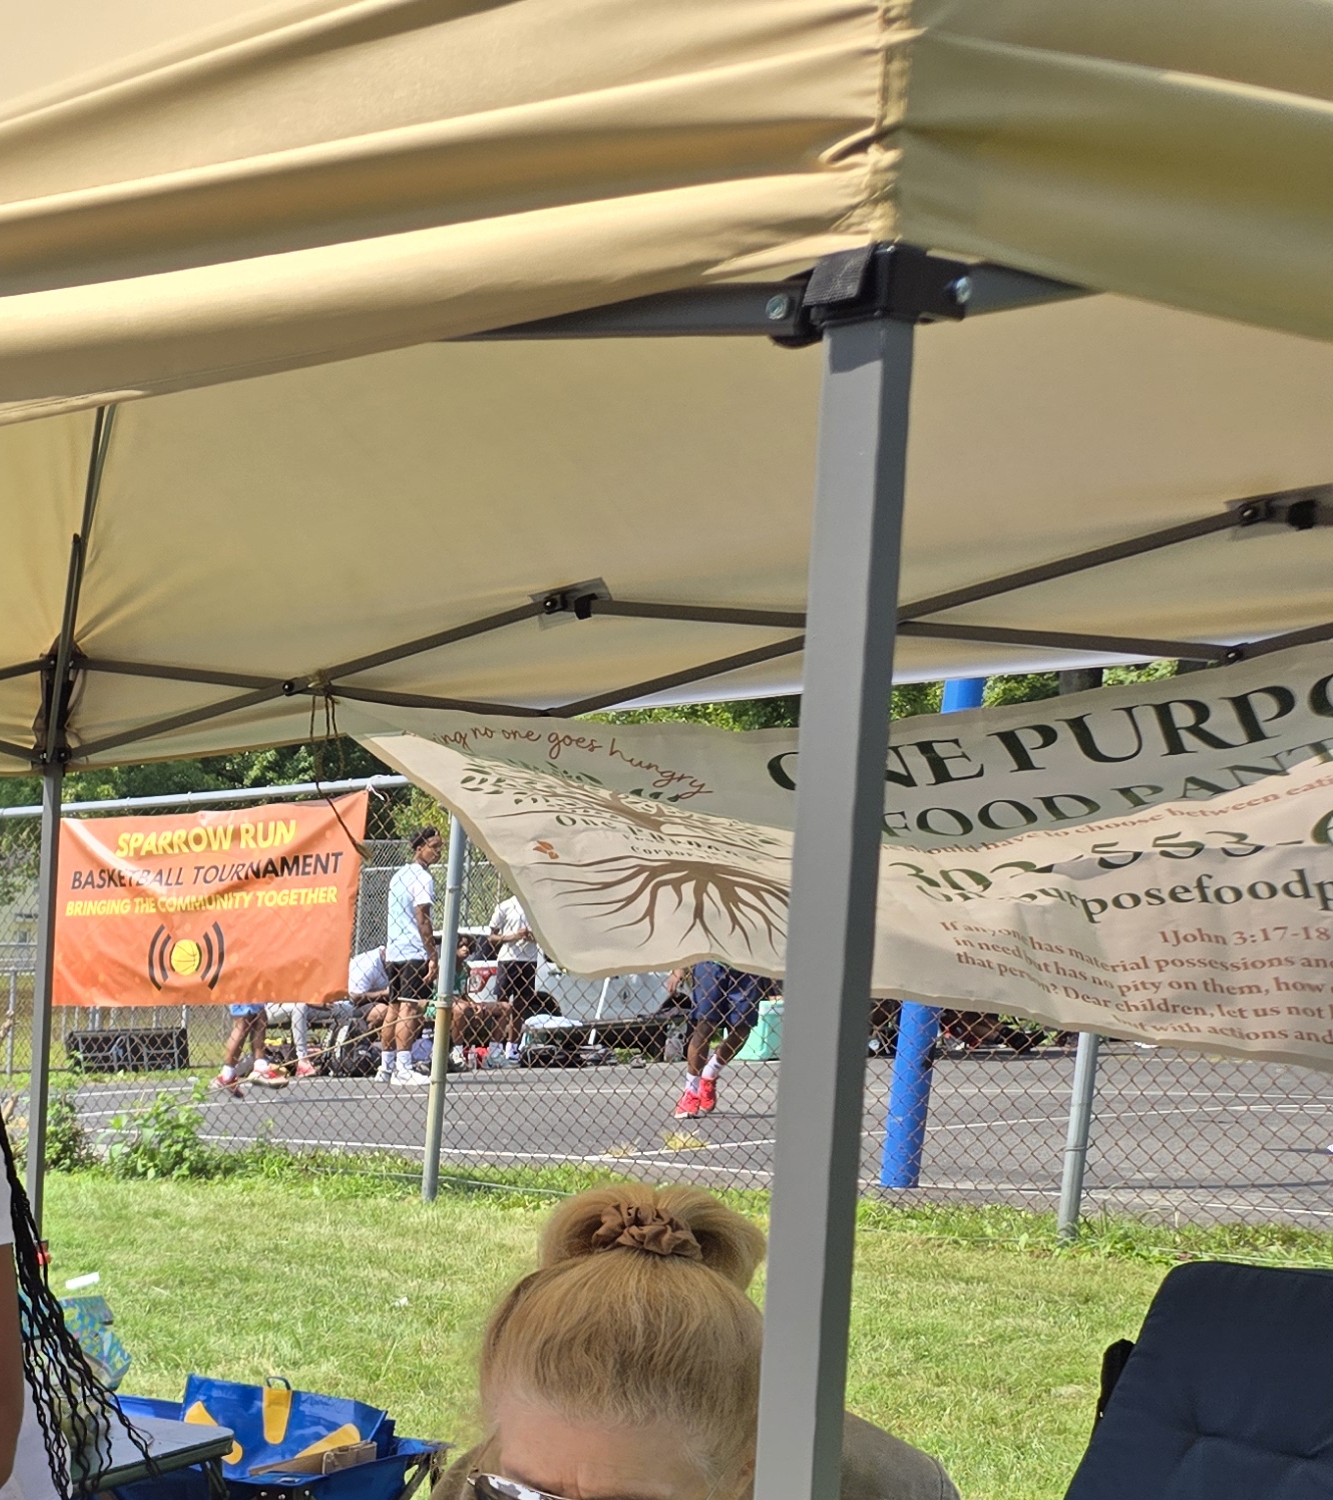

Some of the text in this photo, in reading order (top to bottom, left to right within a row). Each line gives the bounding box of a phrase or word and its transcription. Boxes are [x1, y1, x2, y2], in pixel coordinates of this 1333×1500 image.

[471, 725, 495, 741] no
[502, 728, 542, 743] one
[547, 731, 604, 760] goes
[609, 737, 715, 799] hungry
[882, 793, 1102, 838] FOOD
[1165, 792, 1281, 817] between
[115, 819, 297, 858] SPARROW RUN
[71, 851, 344, 890] BASKETBALL TOURNAMENT
[65, 886, 338, 916] BRINGING THE COMMUNITY TOGETHER
[1028, 936, 1065, 955] has
[1067, 946, 1151, 973] material
[1153, 955, 1296, 973] possessions
[1233, 926, 1332, 947] 3:17-18
[953, 936, 976, 948] in
[977, 941, 1025, 960] need
[1053, 960, 1089, 982] has
[1090, 974, 1115, 990] no
[1116, 980, 1163, 998] pity
[1167, 979, 1199, 992] on
[1201, 977, 1271, 997] them,
[1272, 975, 1326, 993] how
[955, 951, 995, 971] that
[1061, 985, 1112, 1010] Dear
[1114, 997, 1215, 1019] children,
[1215, 1003, 1249, 1020] let
[1251, 1004, 1282, 1019] us
[1285, 1004, 1327, 1020] not
[1150, 1021, 1203, 1034] with
[1206, 1024, 1295, 1041] actions
